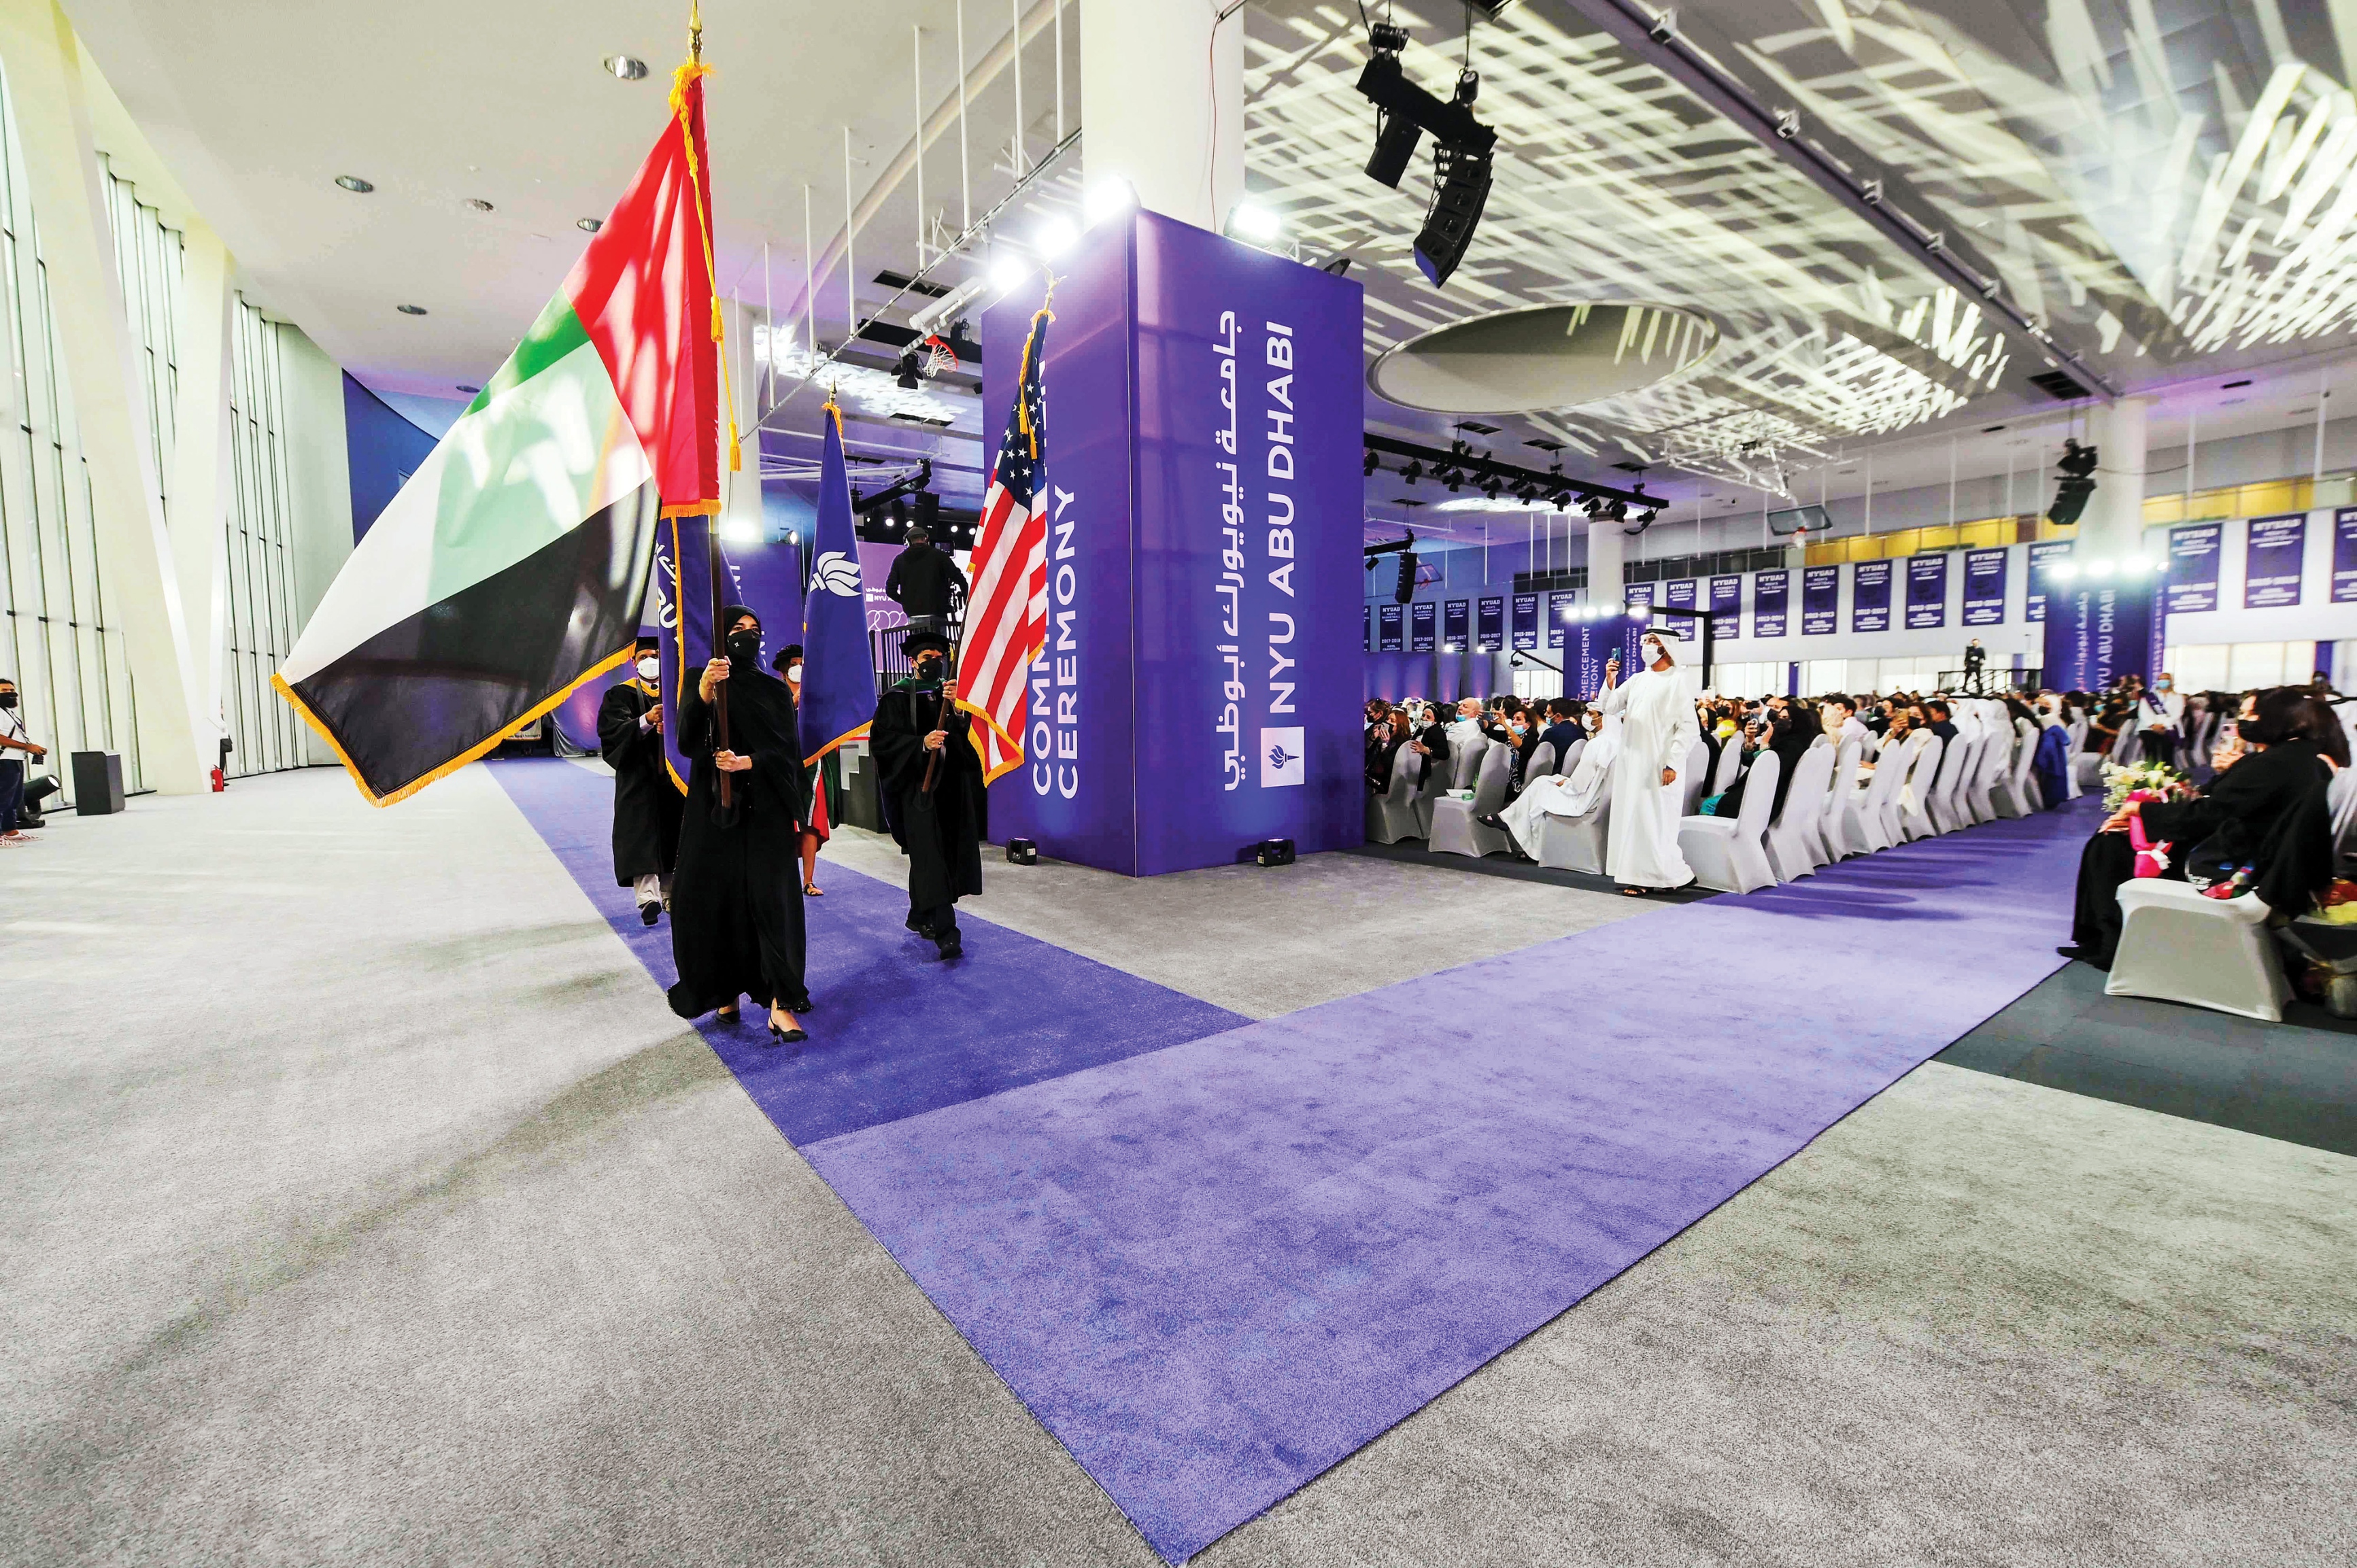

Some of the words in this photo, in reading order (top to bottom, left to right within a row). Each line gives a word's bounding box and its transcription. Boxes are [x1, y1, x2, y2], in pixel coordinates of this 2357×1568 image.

[1213, 310, 1242, 455] جامعة
[1266, 321, 1295, 477] DHABI
[1215, 462, 1244, 636] نيويورك
[1268, 496, 1295, 598] ABU
[1759, 574, 1785, 582] NYUAD
[1054, 484, 1079, 800] CEREMONY
[1269, 613, 1296, 715] NYU
[2097, 634, 2113, 664] ABU
[2098, 589, 2116, 634] DHABI
[1216, 645, 1246, 791] أبوظبي
